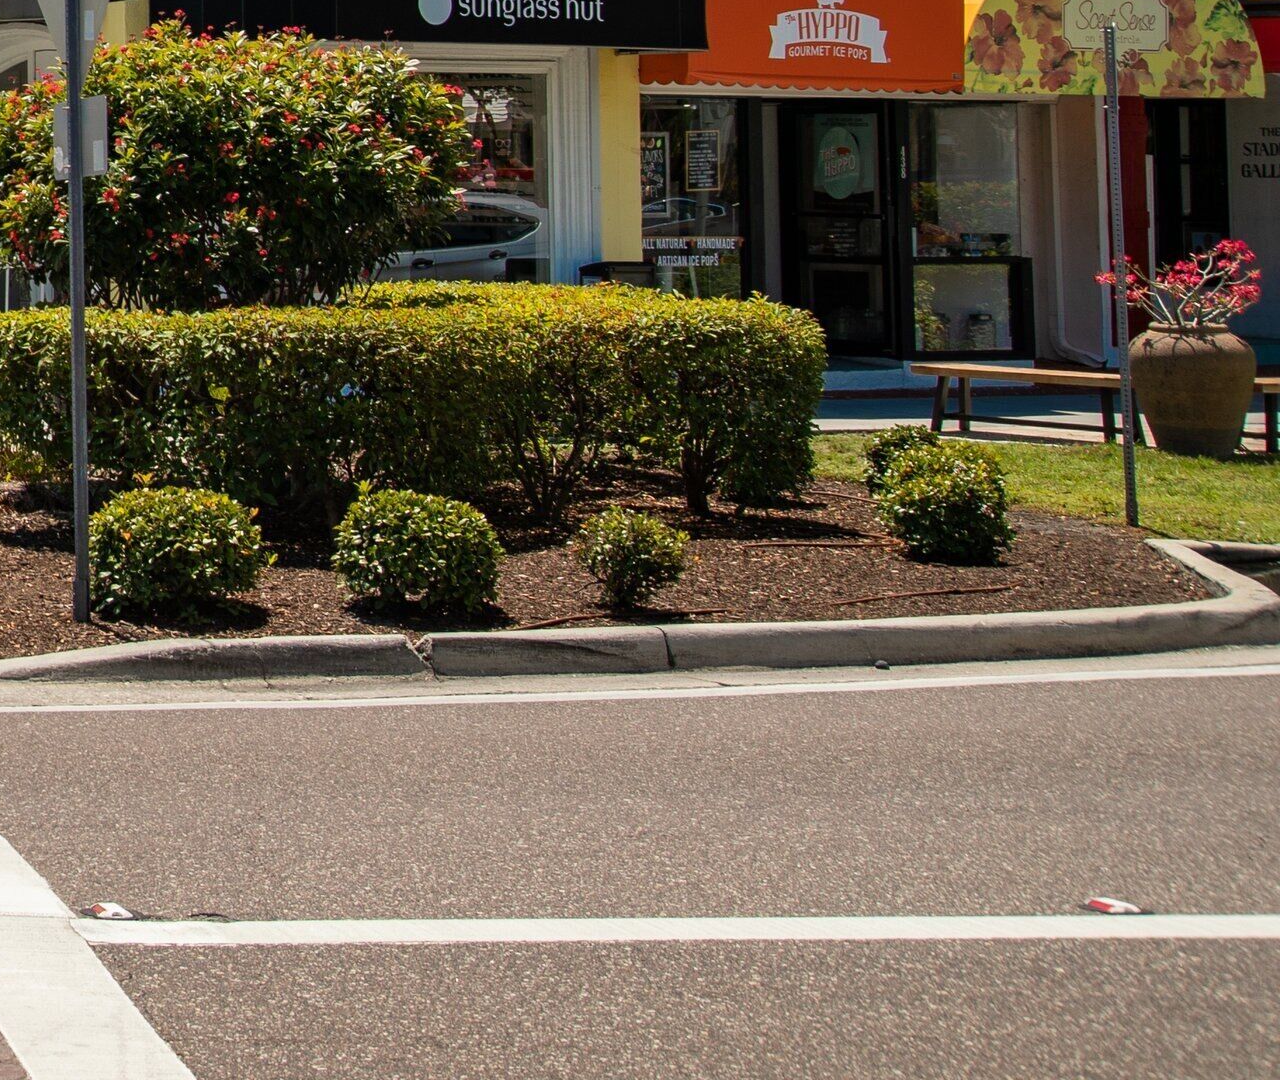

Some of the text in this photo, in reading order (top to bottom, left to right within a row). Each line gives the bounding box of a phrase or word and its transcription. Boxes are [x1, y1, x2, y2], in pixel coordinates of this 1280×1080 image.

[1076, 0, 1156, 31] Scent Sense
[798, 11, 860, 42] HYPPO
[788, 45, 868, 61] GOURMET ICE POPS
[1260, 127, 1280, 137] THE
[1243, 142, 1280, 156] STAD
[1241, 164, 1280, 178] GALL
[642, 238, 736, 250] ALL NATURAL HANDMADE
[656, 255, 720, 267] ARTISAN ICE POPS
